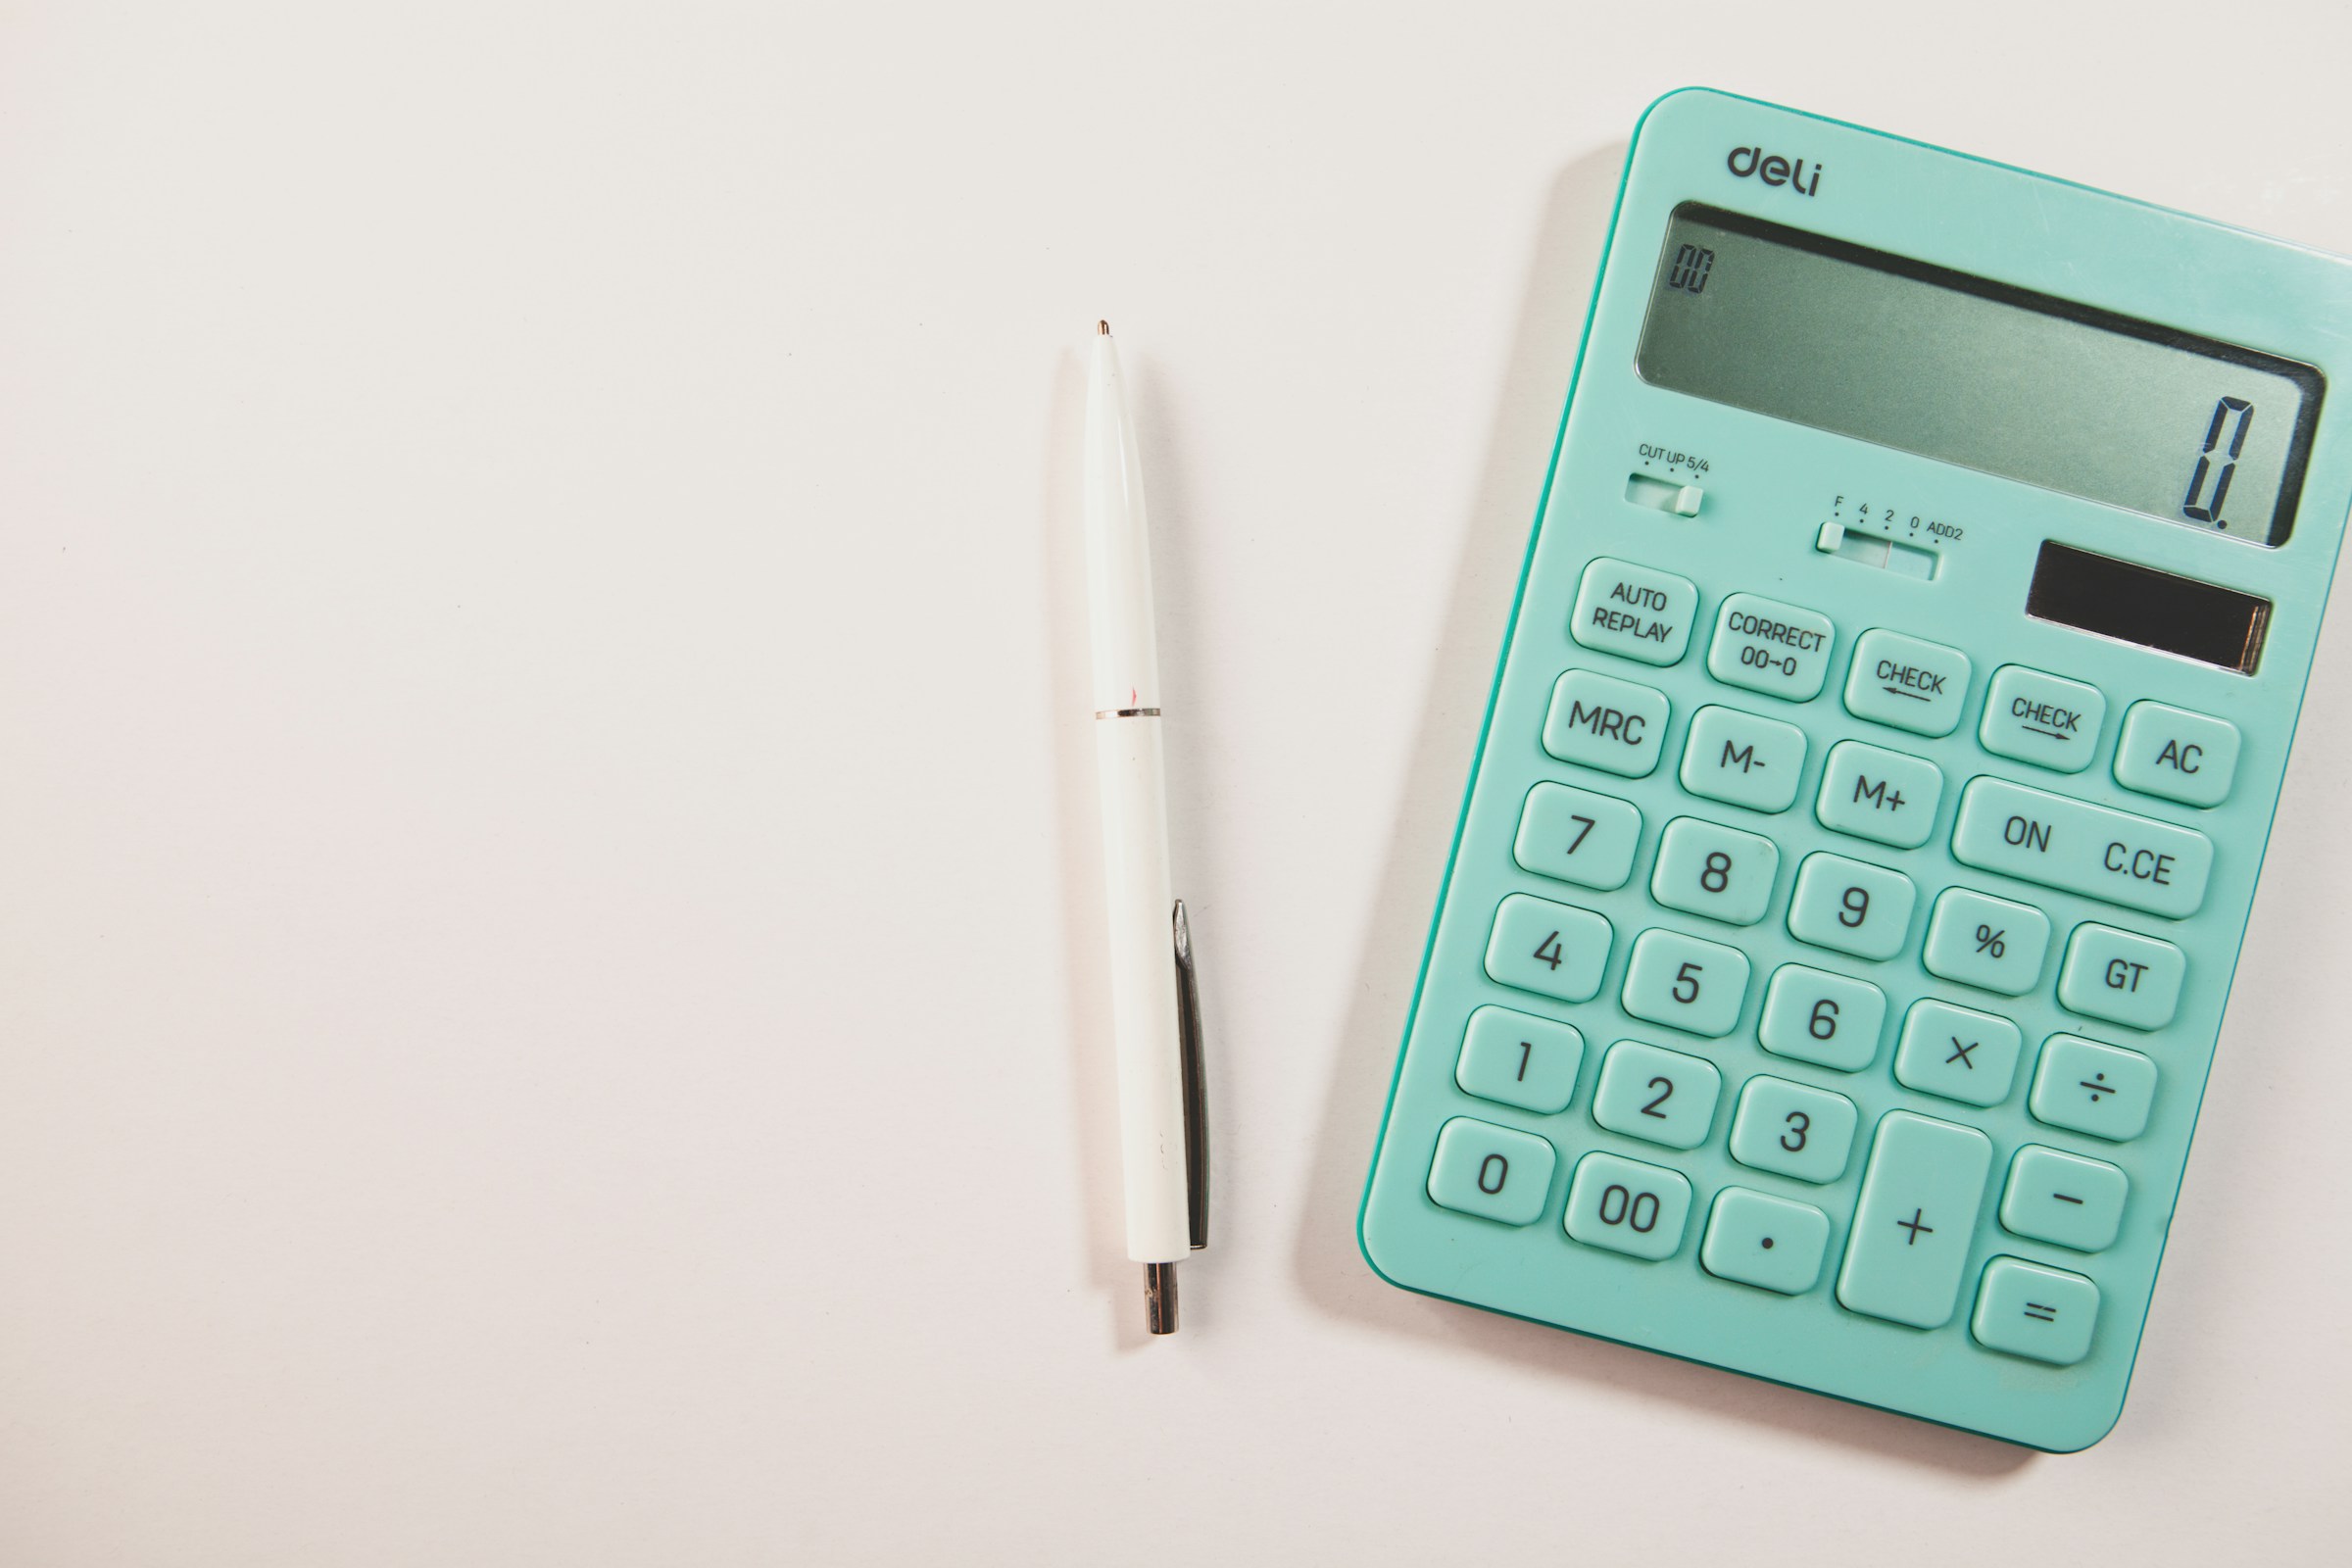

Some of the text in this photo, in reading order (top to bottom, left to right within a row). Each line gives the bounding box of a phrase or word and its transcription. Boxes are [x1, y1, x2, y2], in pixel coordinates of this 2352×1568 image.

[1727, 146, 1823, 197] deli
[1639, 444, 1709, 472] CUT UP 5/4
[1835, 495, 1844, 508] F
[1859, 503, 1868, 514] 4
[1885, 510, 1894, 522] 2
[1927, 521, 1963, 541] ADD2
[1610, 582, 1667, 612] AUTO
[1592, 607, 1673, 644] REPLAY
[1728, 612, 1827, 654] CORRECT
[1876, 660, 1946, 695] CHECK
[1568, 700, 1646, 746] MRC
[2012, 697, 2082, 733] CHECK
[1720, 739, 1766, 774] M-
[2155, 739, 2203, 774] AC
[1852, 774, 1906, 812] M+
[1566, 814, 1596, 856] 7
[2003, 815, 2176, 886] ON C.CE
[1699, 851, 1733, 894] 8
[1838, 886, 1870, 928] 9
[1532, 930, 1563, 971] 4
[1975, 923, 2006, 959] %
[1672, 961, 1703, 1004] 5
[2105, 957, 2149, 993] GT
[1808, 999, 1839, 1041] 6
[1516, 1041, 1532, 1083] 1
[1640, 1076, 1674, 1120] 2
[1780, 1110, 1811, 1153] 3
[1477, 1152, 1509, 1196] 0
[1598, 1184, 1660, 1234] 00
[1896, 1207, 1934, 1246] +
